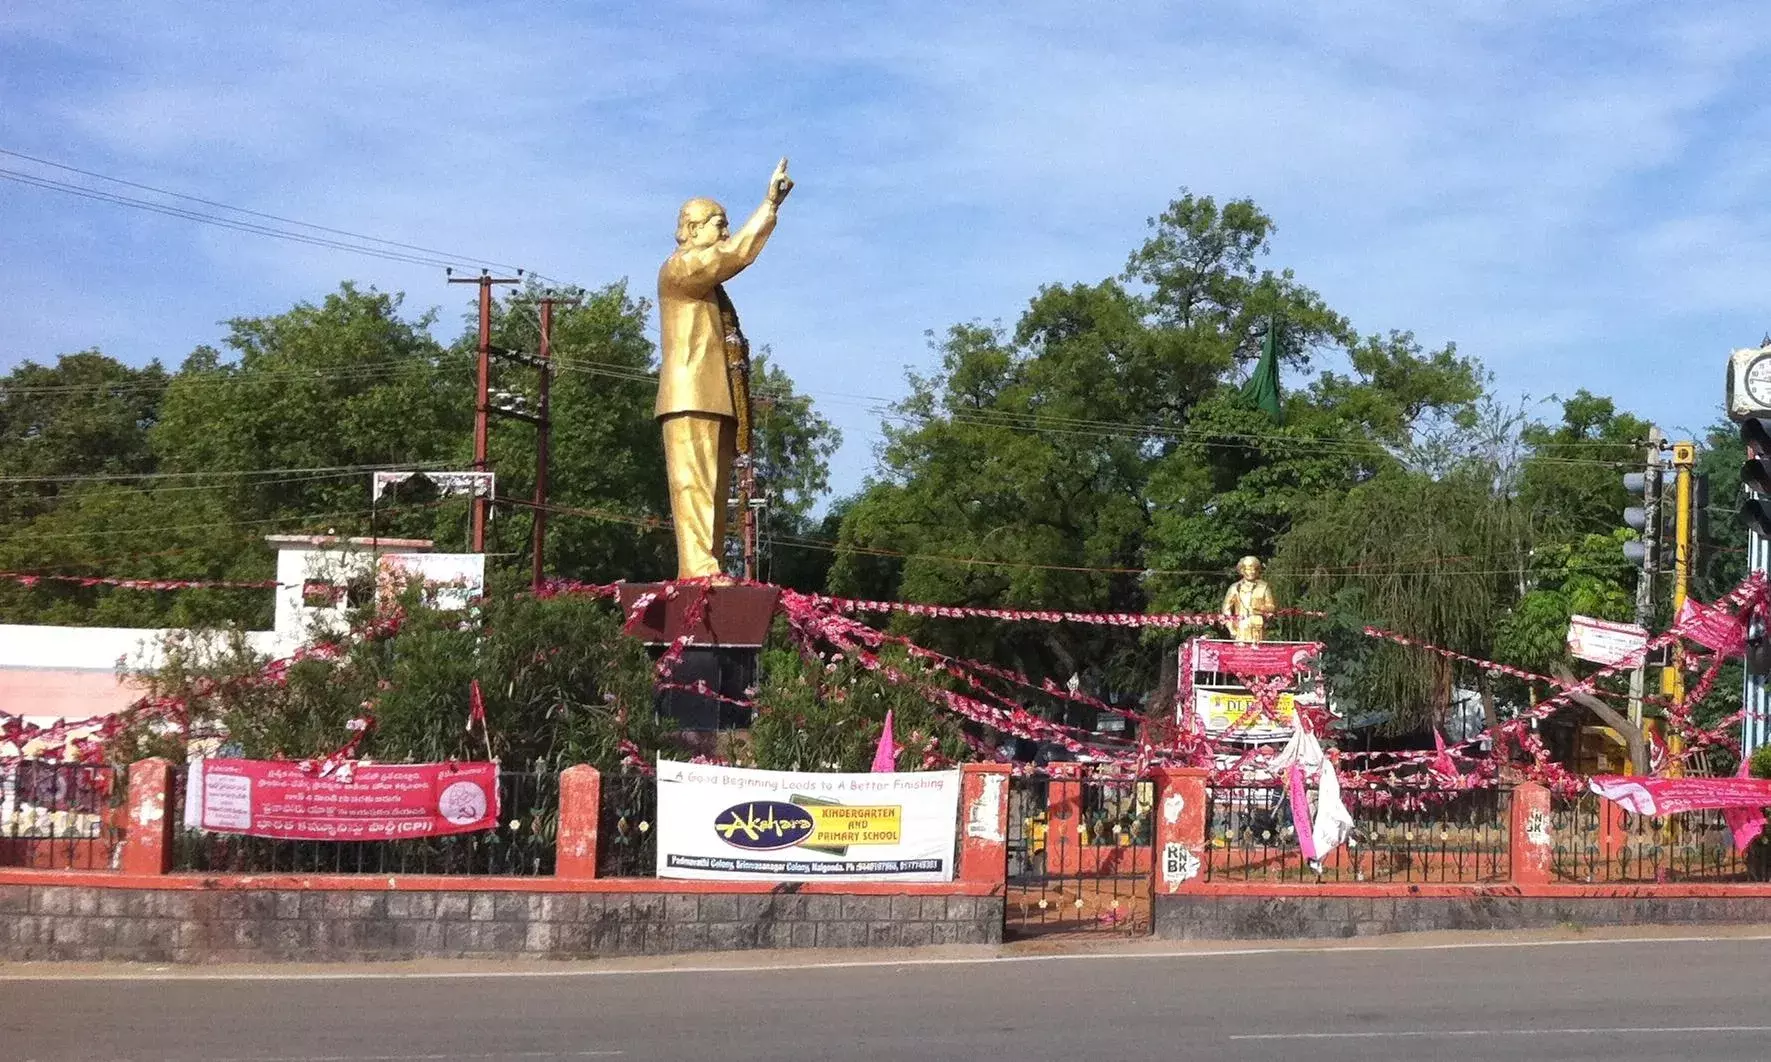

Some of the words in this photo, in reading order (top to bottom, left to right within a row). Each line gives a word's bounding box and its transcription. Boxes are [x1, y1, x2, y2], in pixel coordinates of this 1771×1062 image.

[675, 771, 684, 780] A
[688, 772, 718, 785] Good
[722, 775, 778, 791] Beginning
[821, 781, 832, 791] to
[838, 781, 846, 791] A
[850, 780, 890, 791] Better
[893, 778, 944, 792] Finishing
[821, 808, 895, 818] KINDERGARTEN
[397, 821, 433, 834] (CPI)
[715, 803, 811, 840] Akshara
[848, 820, 868, 829] AND
[817, 831, 859, 842] PRIMARY
[862, 831, 898, 841] SCHOOL
